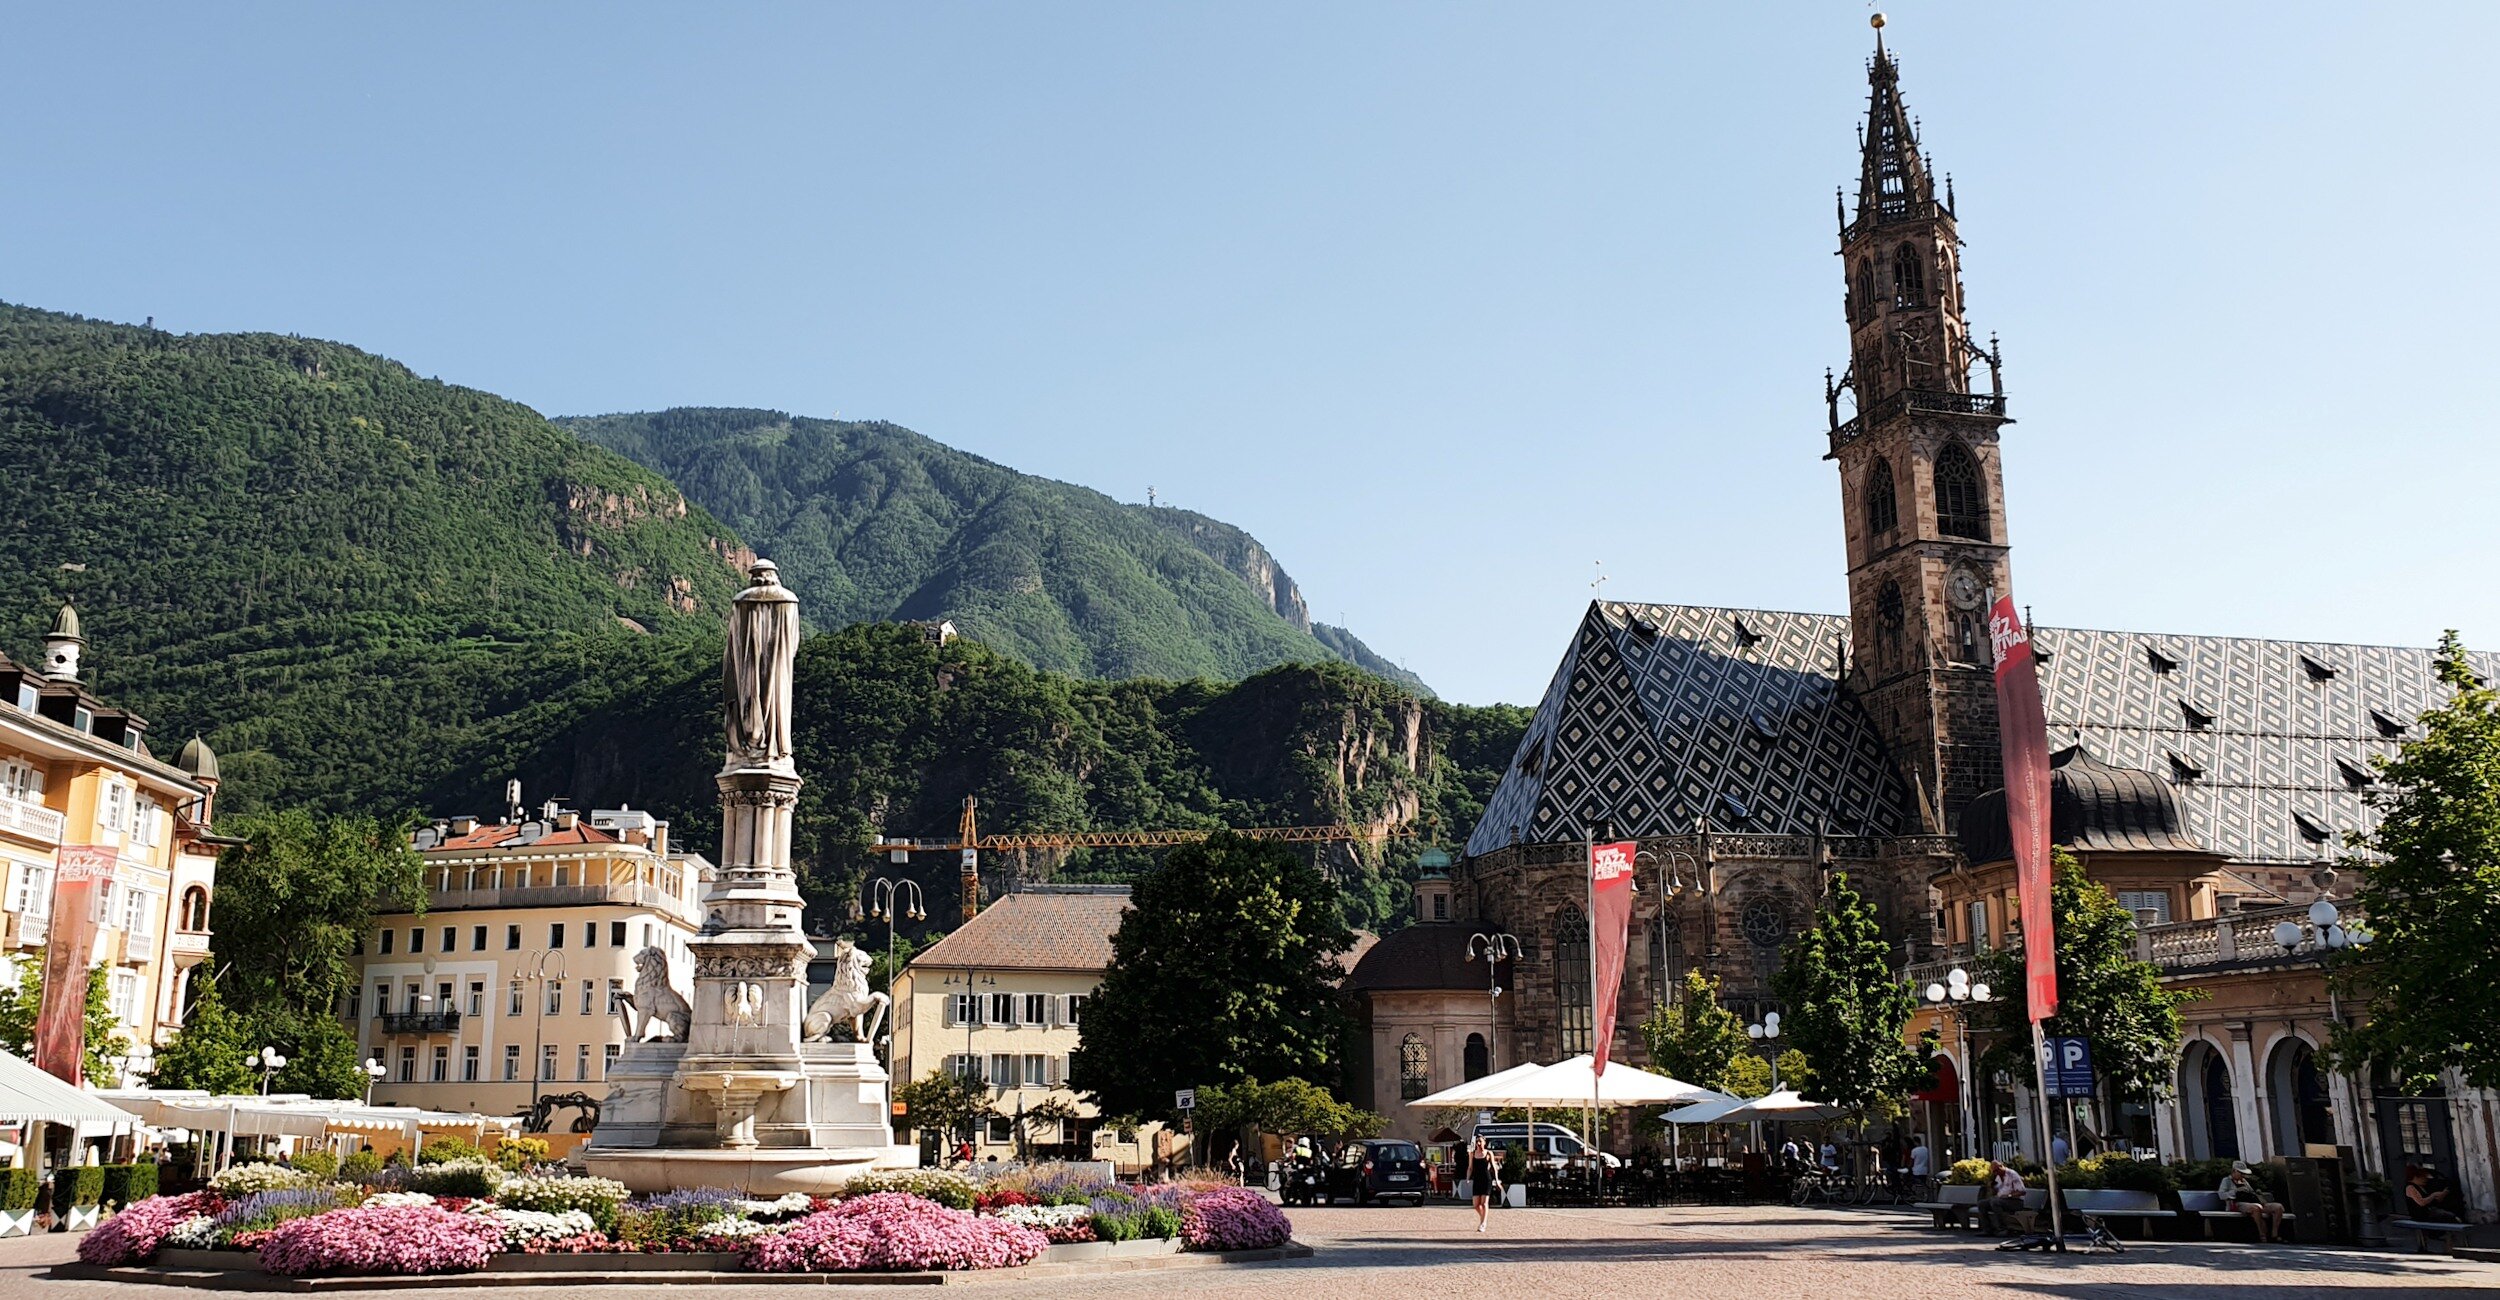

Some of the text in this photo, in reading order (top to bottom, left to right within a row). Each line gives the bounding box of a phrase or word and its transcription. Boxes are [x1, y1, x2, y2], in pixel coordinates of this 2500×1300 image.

[60, 856, 104, 869] JAZZ
[1595, 853, 1627, 868] JAZZ
[59, 865, 113, 877] FESTIVAL
[2043, 1047, 2053, 1070] P
[2063, 1046, 2083, 1069] P
[1992, 1141, 2019, 1163] OUTLE
